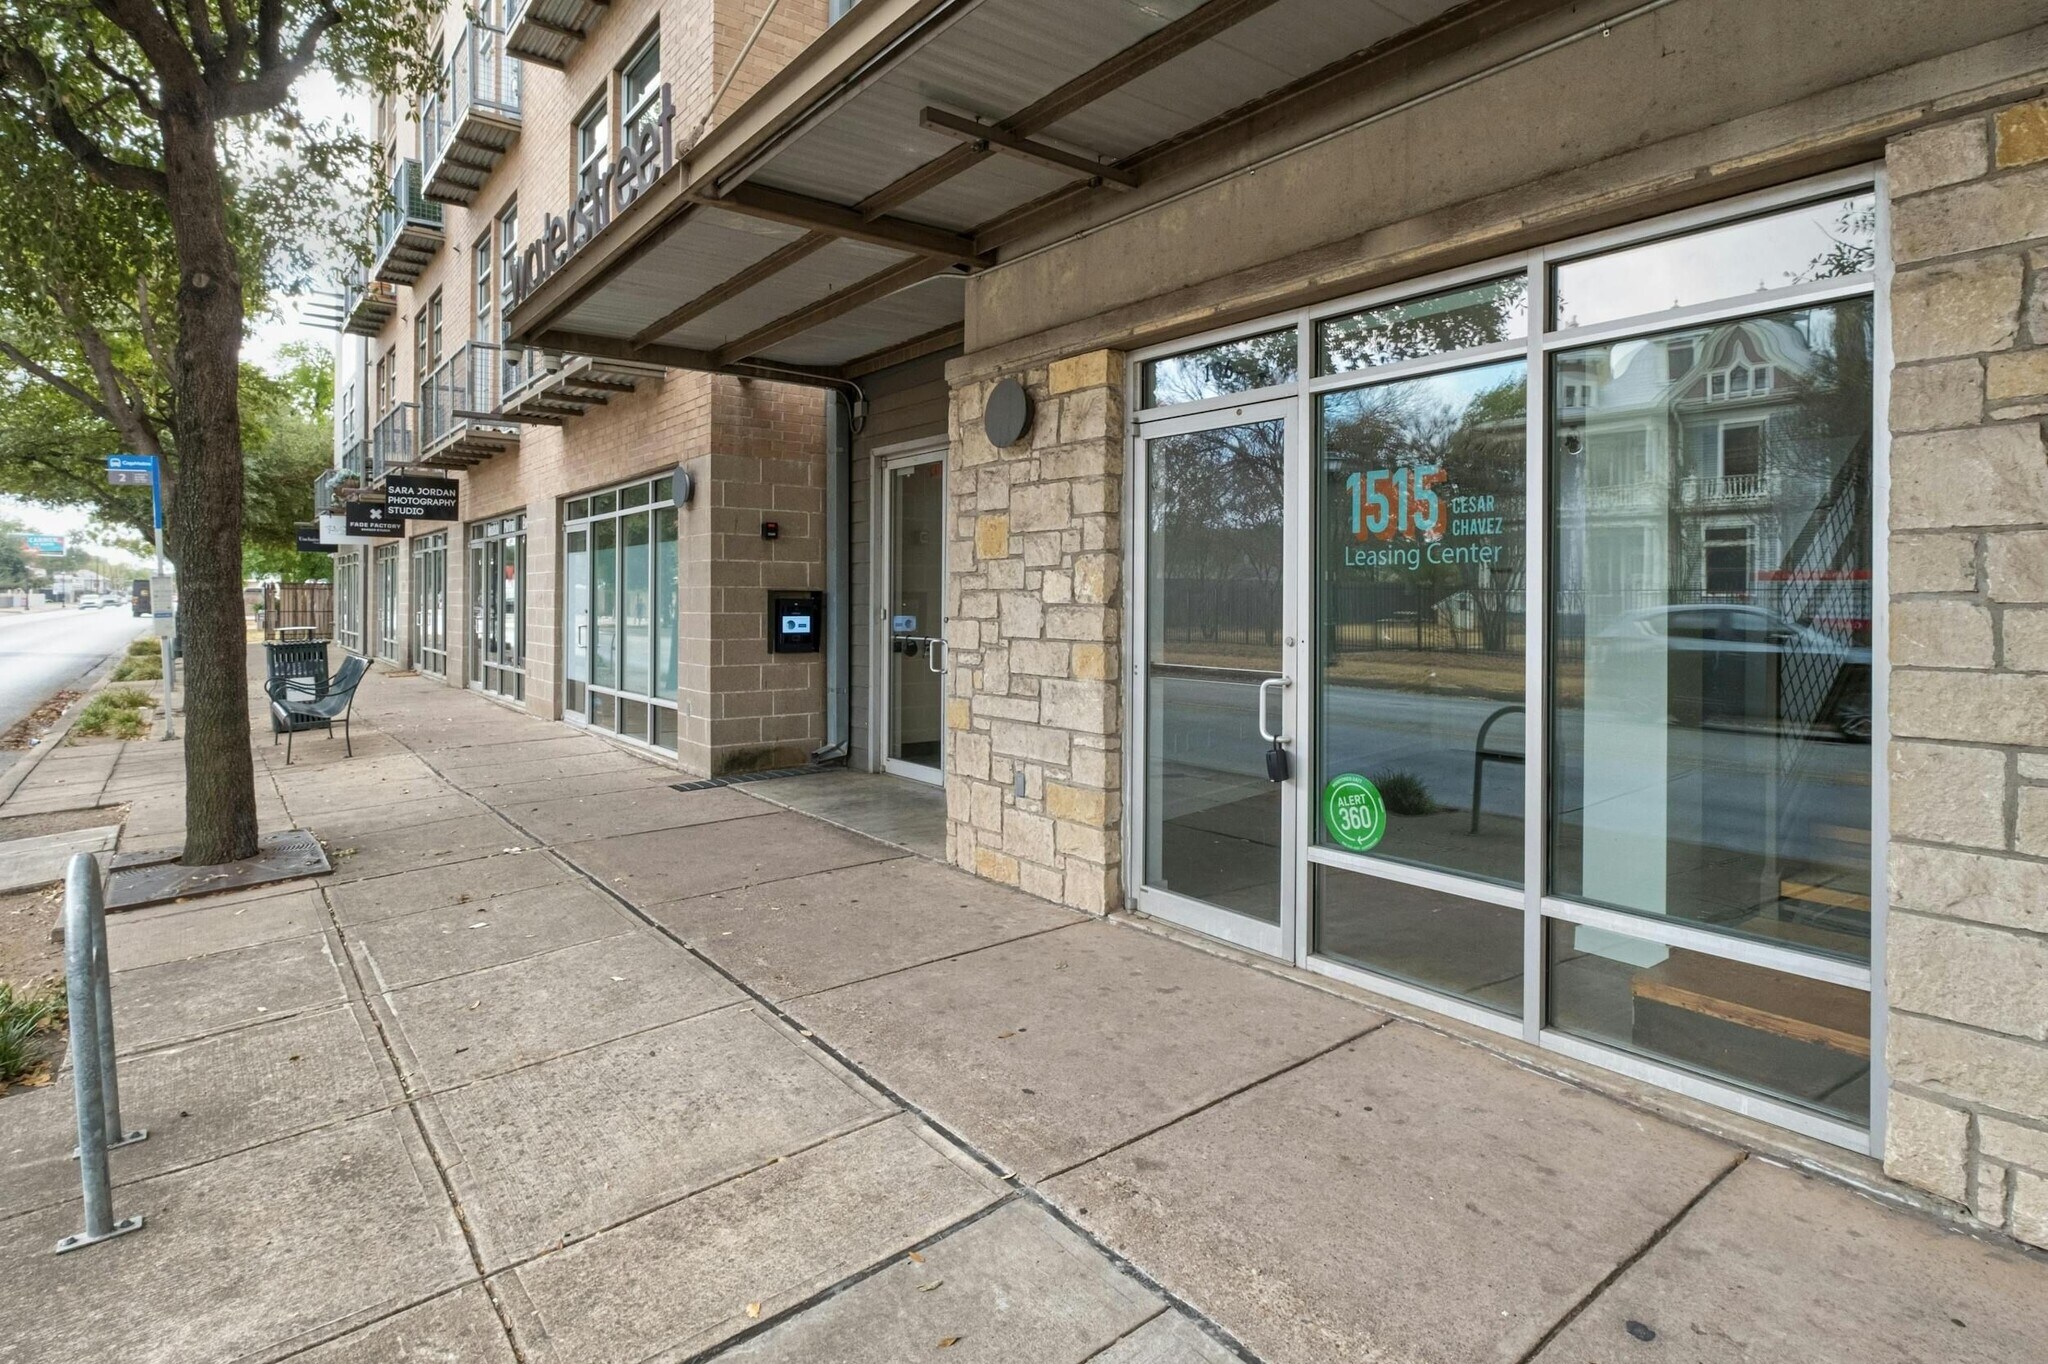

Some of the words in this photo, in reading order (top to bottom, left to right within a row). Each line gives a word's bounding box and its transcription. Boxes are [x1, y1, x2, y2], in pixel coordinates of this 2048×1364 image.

[118, 473, 126, 482] 2
[388, 486, 414, 494] SARA
[417, 488, 456, 496] JORDAN
[388, 496, 456, 506] PHOTOGRAPHY
[1346, 464, 1443, 536] 1515
[1452, 495, 1494, 513] CESAR
[388, 507, 424, 515] STUDIO
[1452, 517, 1503, 536] CHAVEZ
[1345, 545, 1420, 570] Leasing
[1427, 542, 1503, 565] Center
[1338, 793, 1366, 807] ALERT
[1339, 805, 1371, 830] 360
